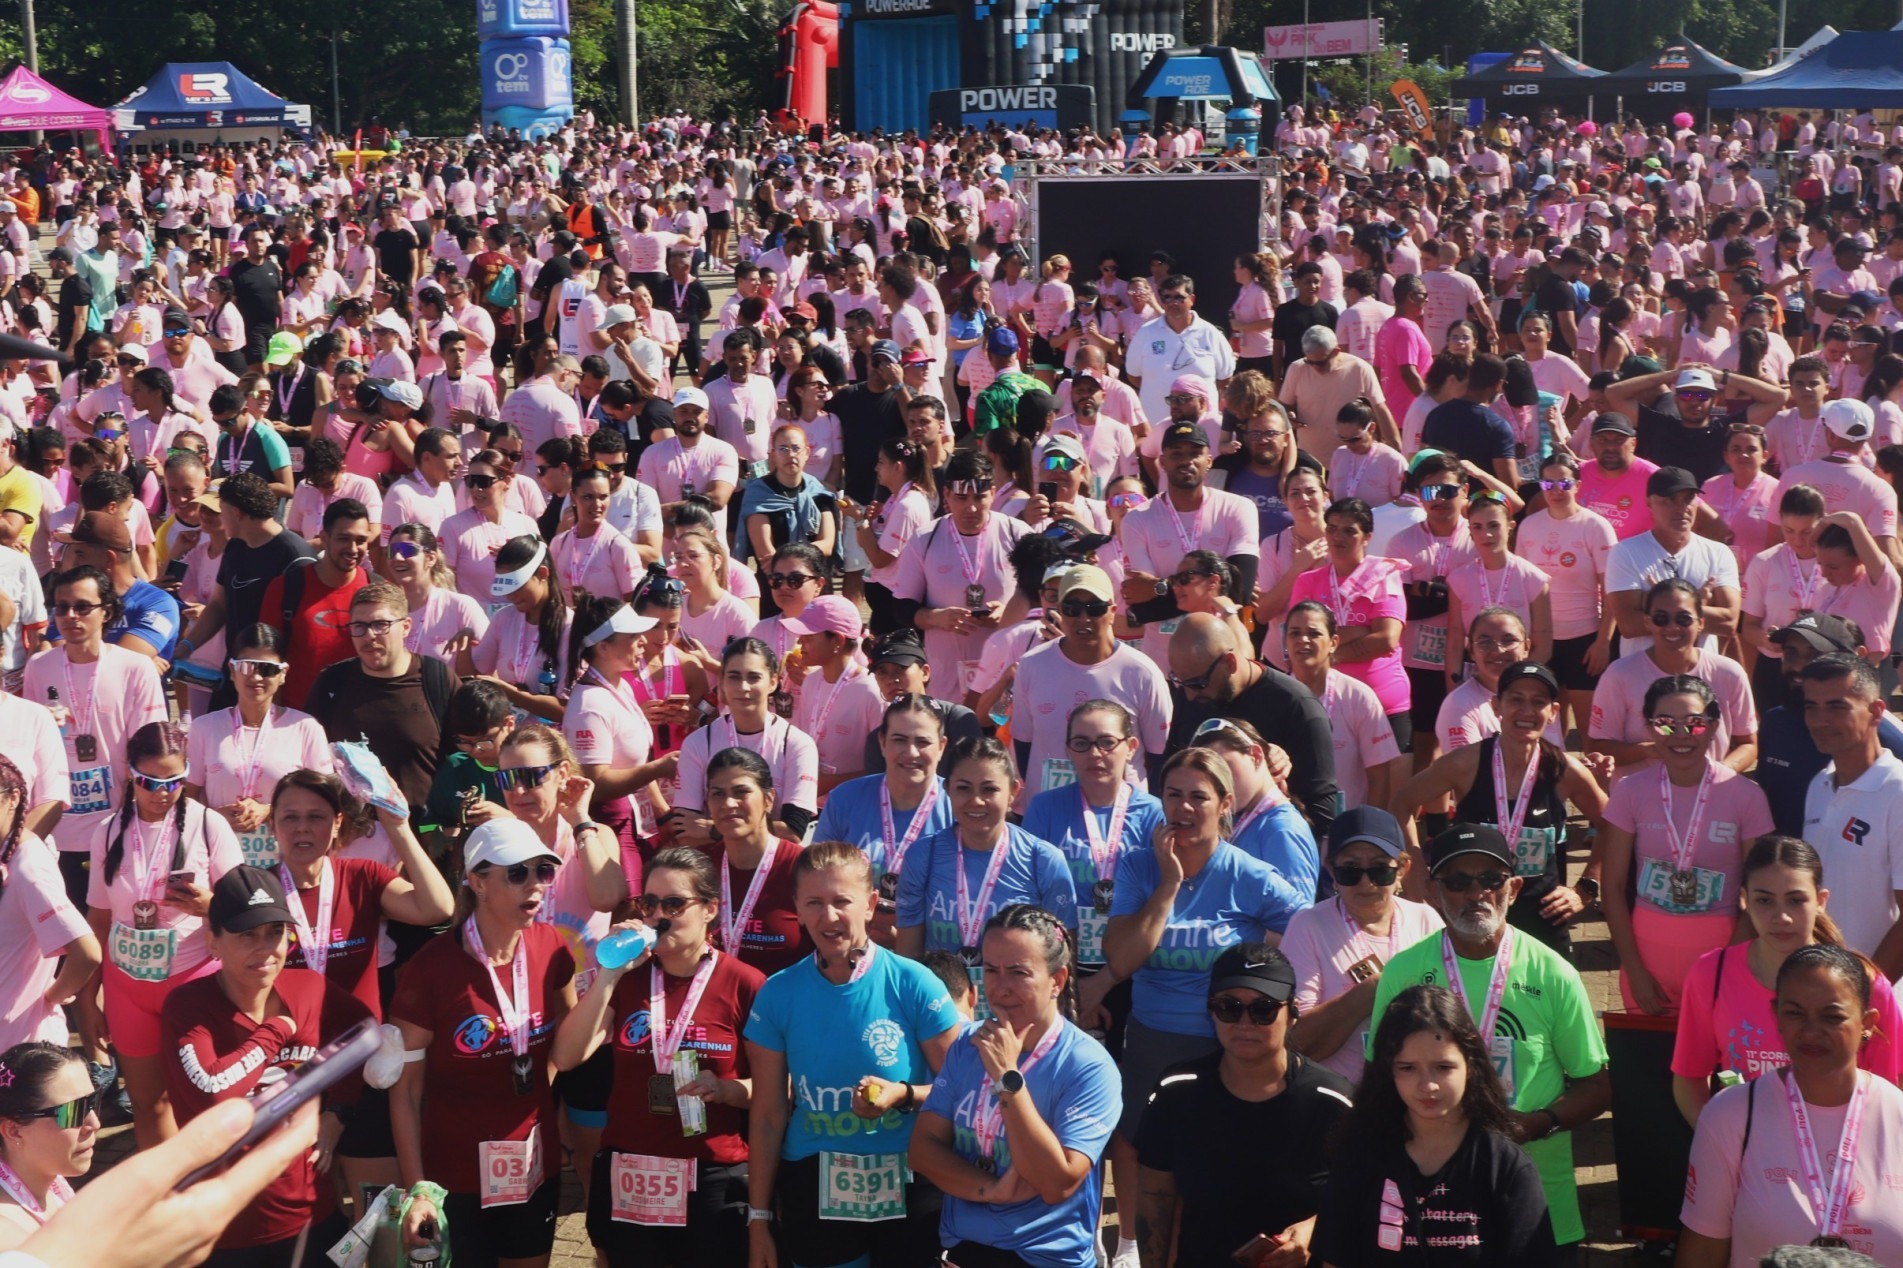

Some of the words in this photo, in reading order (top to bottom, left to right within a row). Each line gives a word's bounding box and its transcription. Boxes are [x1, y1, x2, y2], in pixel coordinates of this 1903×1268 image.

[520, 7, 554, 20] tem
[1110, 33, 1176, 51] POWER
[495, 80, 530, 93] tem
[1165, 75, 1212, 86] POWER
[1647, 82, 1687, 93] JCB
[1502, 84, 1540, 95] JCB
[960, 86, 1058, 112] POWER
[1401, 93, 1429, 130] JCB
[1051, 772, 1073, 787] 77
[71, 780, 103, 798] 084
[241, 836, 276, 852] 308
[1515, 841, 1542, 857] 67
[741, 933, 785, 942] CARENHAS
[1081, 922, 1108, 940] 34
[117, 939, 166, 960] 6089
[679, 1040, 732, 1051] CARENHAS
[1759, 1050, 1792, 1061] CORR
[1842, 1137, 1852, 1159] POLI
[492, 1158, 524, 1178] 03
[621, 1172, 679, 1197] 0355
[835, 1170, 895, 1194] 6391
[1830, 1203, 1841, 1224] POLI
